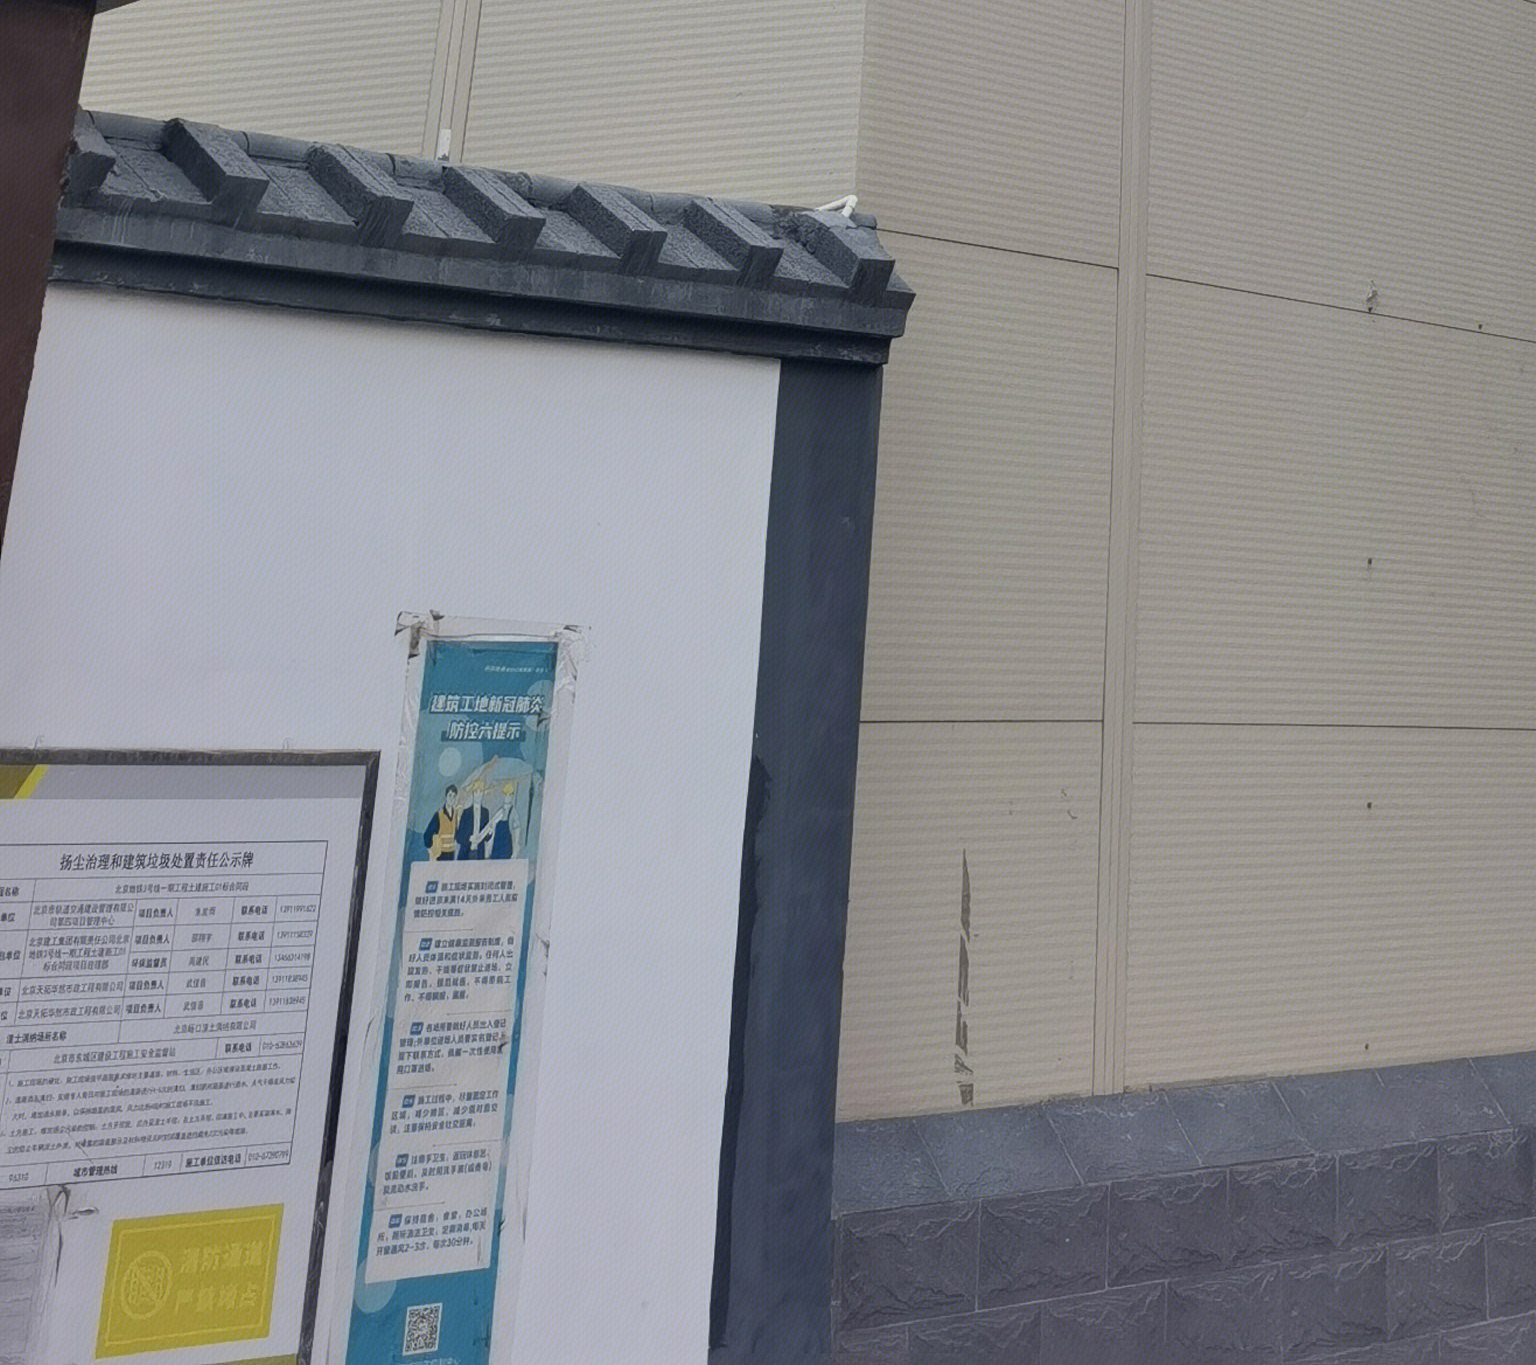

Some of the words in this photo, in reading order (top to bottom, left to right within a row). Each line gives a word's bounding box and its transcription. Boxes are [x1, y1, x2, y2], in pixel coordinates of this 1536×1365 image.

[430, 694, 544, 713] 建筑工地新冠肺炎
[449, 721, 521, 740] 防控六提示
[59, 851, 254, 871] 扬尘治理和建筑垃圾处置责任公示牌
[138, 908, 174, 918] 项目负责人
[241, 905, 268, 916] 联系电话
[134, 934, 170, 945] 项目负责人
[238, 931, 265, 941] 联系电话
[235, 954, 262, 965] 联系电话
[128, 979, 164, 991] 项目负责人
[232, 976, 260, 986] 联系电话
[125, 1003, 161, 1014] 项目负责人
[229, 998, 257, 1009] 联系电话
[225, 1042, 252, 1053] 联系电话
